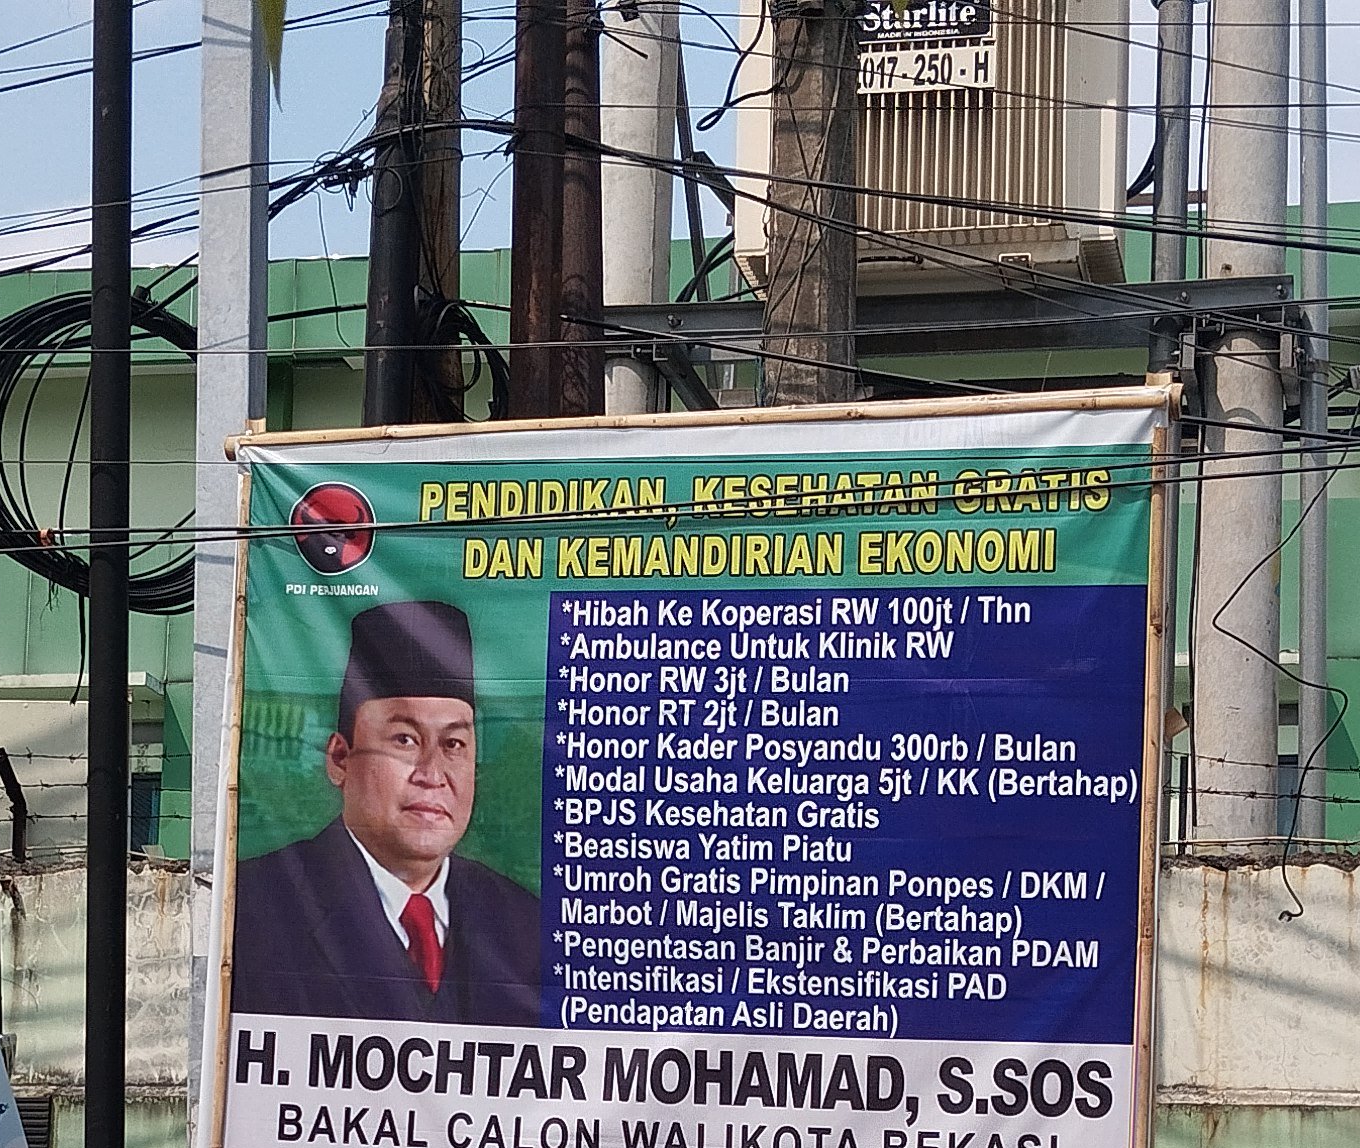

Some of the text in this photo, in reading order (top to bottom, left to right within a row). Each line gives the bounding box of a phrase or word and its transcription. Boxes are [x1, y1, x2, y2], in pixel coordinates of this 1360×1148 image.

[877, 31, 902, 39] MADE
[913, 28, 961, 38] INDONESIA
[914, 53, 953, 86] 250
[974, 51, 989, 83] H
[420, 467, 1112, 530] PENDIDIKAN, KESEHATAN GRATIS
[463, 528, 1058, 580] DAN KEMANDIRIAN EKONOMI
[285, 584, 379, 596] PDI PERJUANGAN
[658, 599, 693, 627] Ke
[701, 598, 822, 632] Koperasi
[831, 597, 879, 625] RW
[888, 596, 953, 631] 100jt
[960, 596, 970, 625] /
[978, 596, 1031, 624] Thn
[730, 632, 810, 660] Untuk
[818, 631, 896, 660] Klinik
[905, 631, 954, 659] RW
[660, 666, 707, 693] RW
[713, 666, 747, 699] 3jt
[754, 665, 763, 694] /
[771, 666, 849, 693] Bulan
[658, 699, 696, 726] RT
[703, 699, 737, 733] 2jt
[744, 698, 753, 727] /
[761, 699, 839, 727] Bulan
[657, 732, 738, 760] Kader
[745, 732, 881, 768] Posyandu
[890, 733, 969, 762] 300rb
[976, 733, 986, 762] /
[994, 733, 1076, 762] Bulan
[654, 765, 738, 794] Usaha
[747, 766, 869, 802] Keluarga
[878, 767, 912, 803] 5jt
[919, 767, 929, 796] /
[937, 768, 979, 796] KK
[988, 768, 1139, 804] (Bertahap)
[645, 799, 788, 828] Kesehatan
[796, 801, 880, 829] Gratis
[698, 833, 773, 862] Yatim
[783, 834, 852, 862] Piatu
[661, 866, 741, 894] Gratis
[750, 867, 879, 901] Pimpinan
[888, 869, 994, 905] Ponpes
[1002, 870, 1012, 899] /
[1020, 871, 1087, 899] DKM
[1095, 872, 1106, 900] /
[561, 897, 1022, 940] Marbot / Majelis Taklim (Bertahap)
[745, 933, 825, 969] Banjir
[833, 936, 853, 964] &
[862, 936, 1001, 967] Perbaikan
[1011, 939, 1099, 969] PDAM
[731, 967, 740, 995] /
[747, 967, 939, 999] Ekstensifikasi
[948, 972, 1007, 1000] PAD
[561, 996, 898, 1039] (Pendapatan Asli Daerah)
[234, 1029, 1114, 1127] H. MOCHTAR MOHAMAD, S.SOS
[277, 1104, 428, 1148] BAKAL
